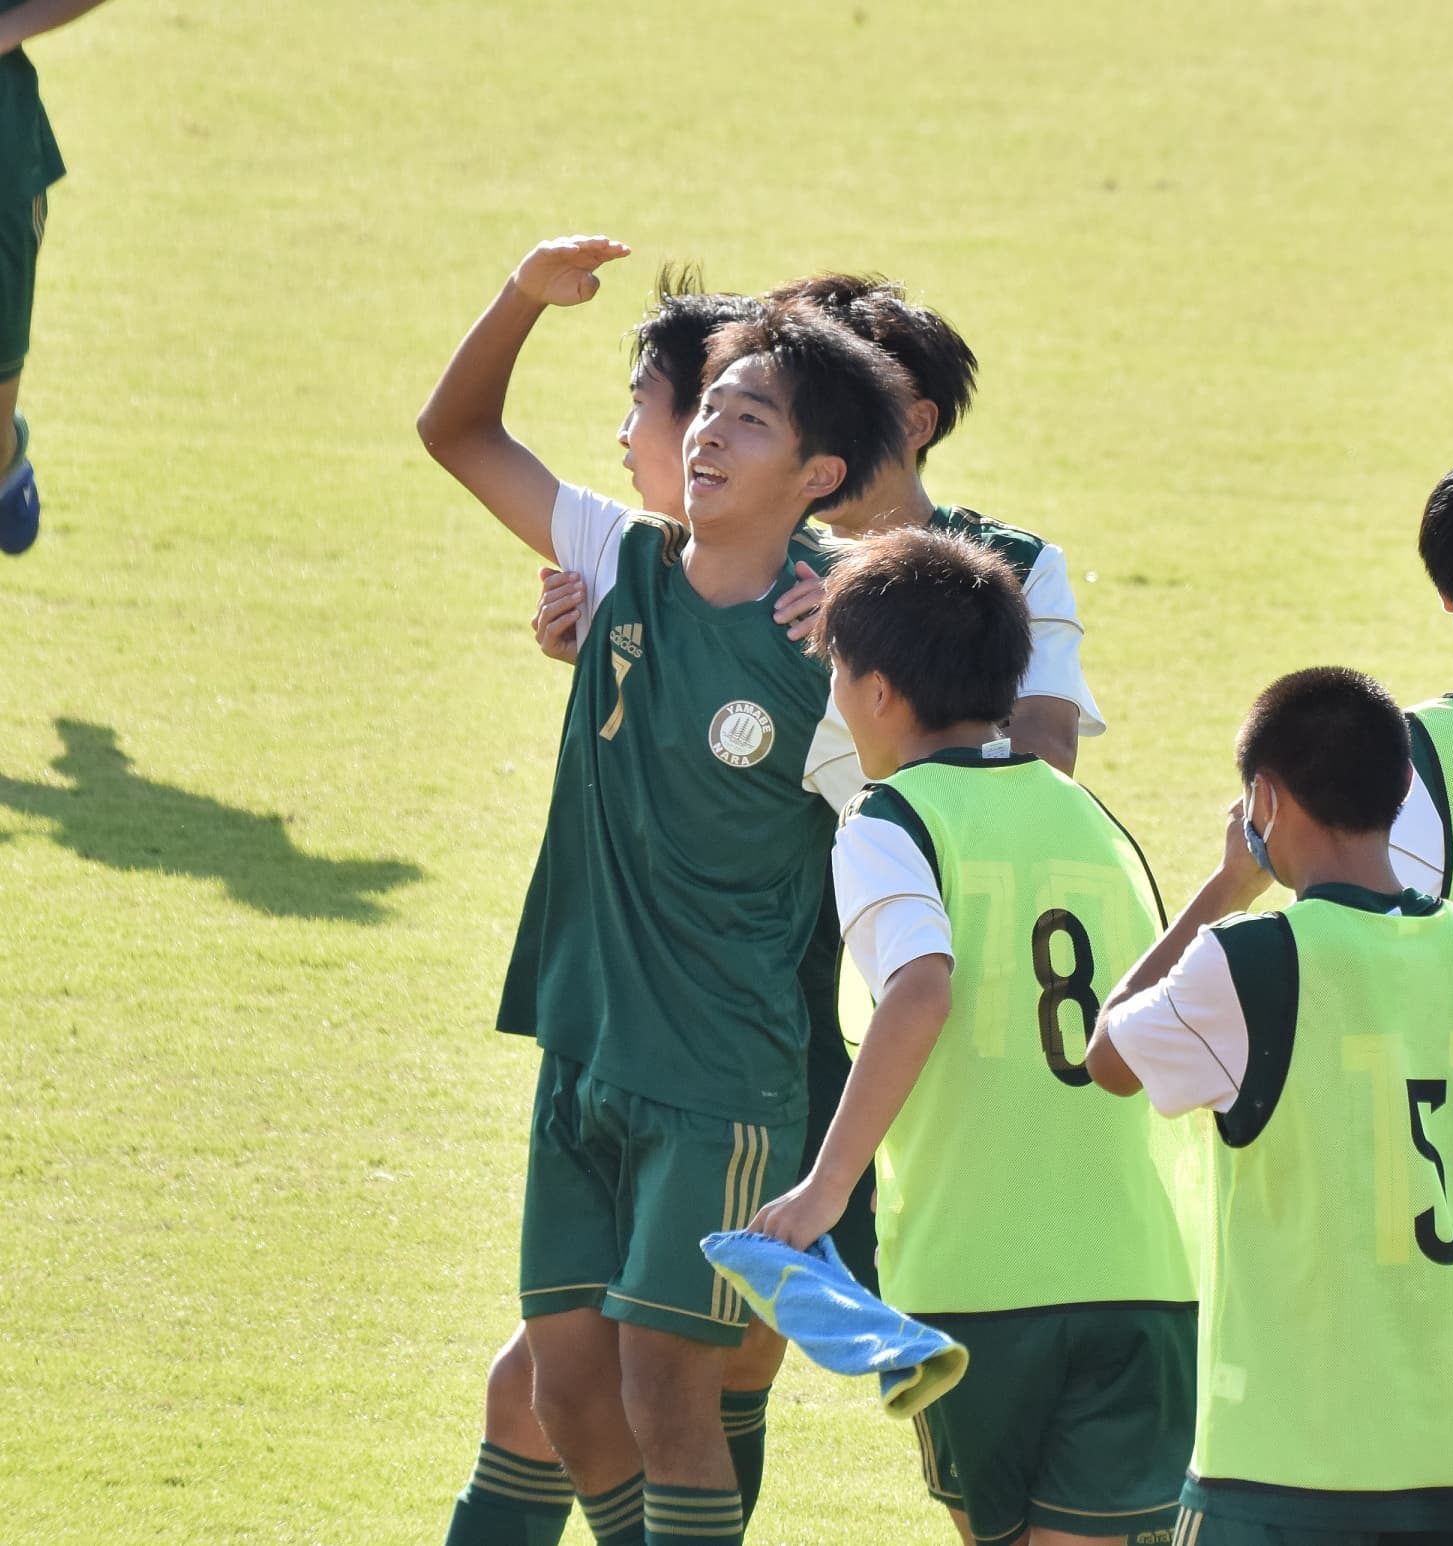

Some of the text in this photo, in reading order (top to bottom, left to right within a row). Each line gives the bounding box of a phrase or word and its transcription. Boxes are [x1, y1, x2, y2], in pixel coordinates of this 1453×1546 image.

[610, 630, 643, 659] adidas
[599, 649, 632, 741] 7
[726, 702, 772, 735] YAMABE
[712, 741, 751, 766] NARA
[1032, 908, 1101, 1088] 8
